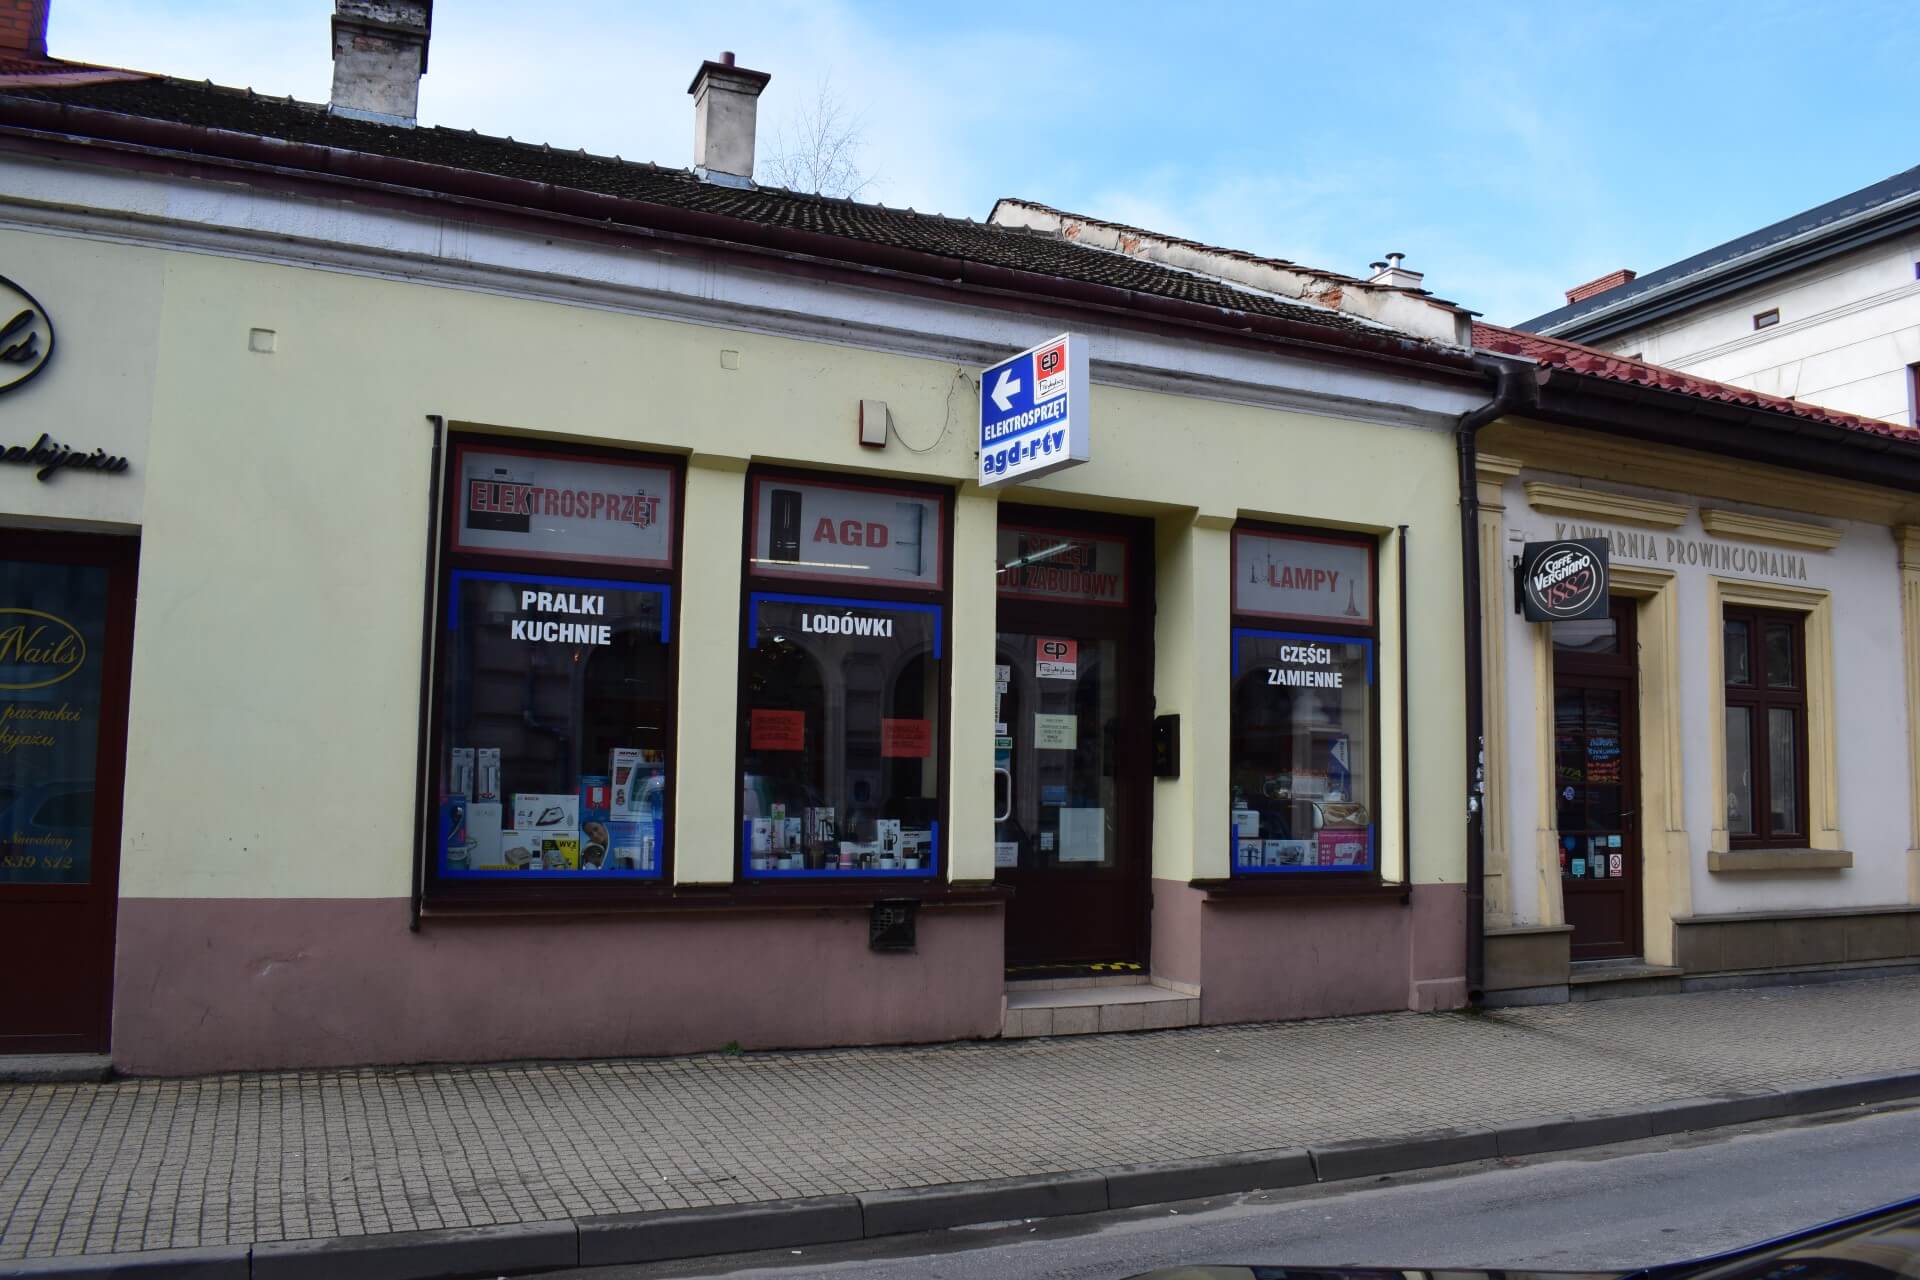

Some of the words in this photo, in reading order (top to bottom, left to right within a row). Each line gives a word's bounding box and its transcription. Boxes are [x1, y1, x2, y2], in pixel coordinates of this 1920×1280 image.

[984, 398, 1066, 440] ELEKTROSPRZĘT
[983, 429, 1066, 475] agd-rtv
[470, 480, 661, 529] ELEKTROSPRZĘT
[813, 518, 889, 548] AGD
[1534, 555, 1591, 592] VERGNANO
[1666, 537, 1808, 582] PROWINCJONALNA
[1024, 566, 1119, 596] ZABUDOWY
[1268, 564, 1340, 593] LAMPY
[1546, 570, 1591, 609] 1882
[521, 590, 605, 616] PRALKI
[511, 619, 612, 646] KUCHNIE
[802, 611, 893, 637] LODÓWKI
[1280, 643, 1331, 666] CZĘŚCI
[1267, 668, 1344, 689] ZAMIENNE
